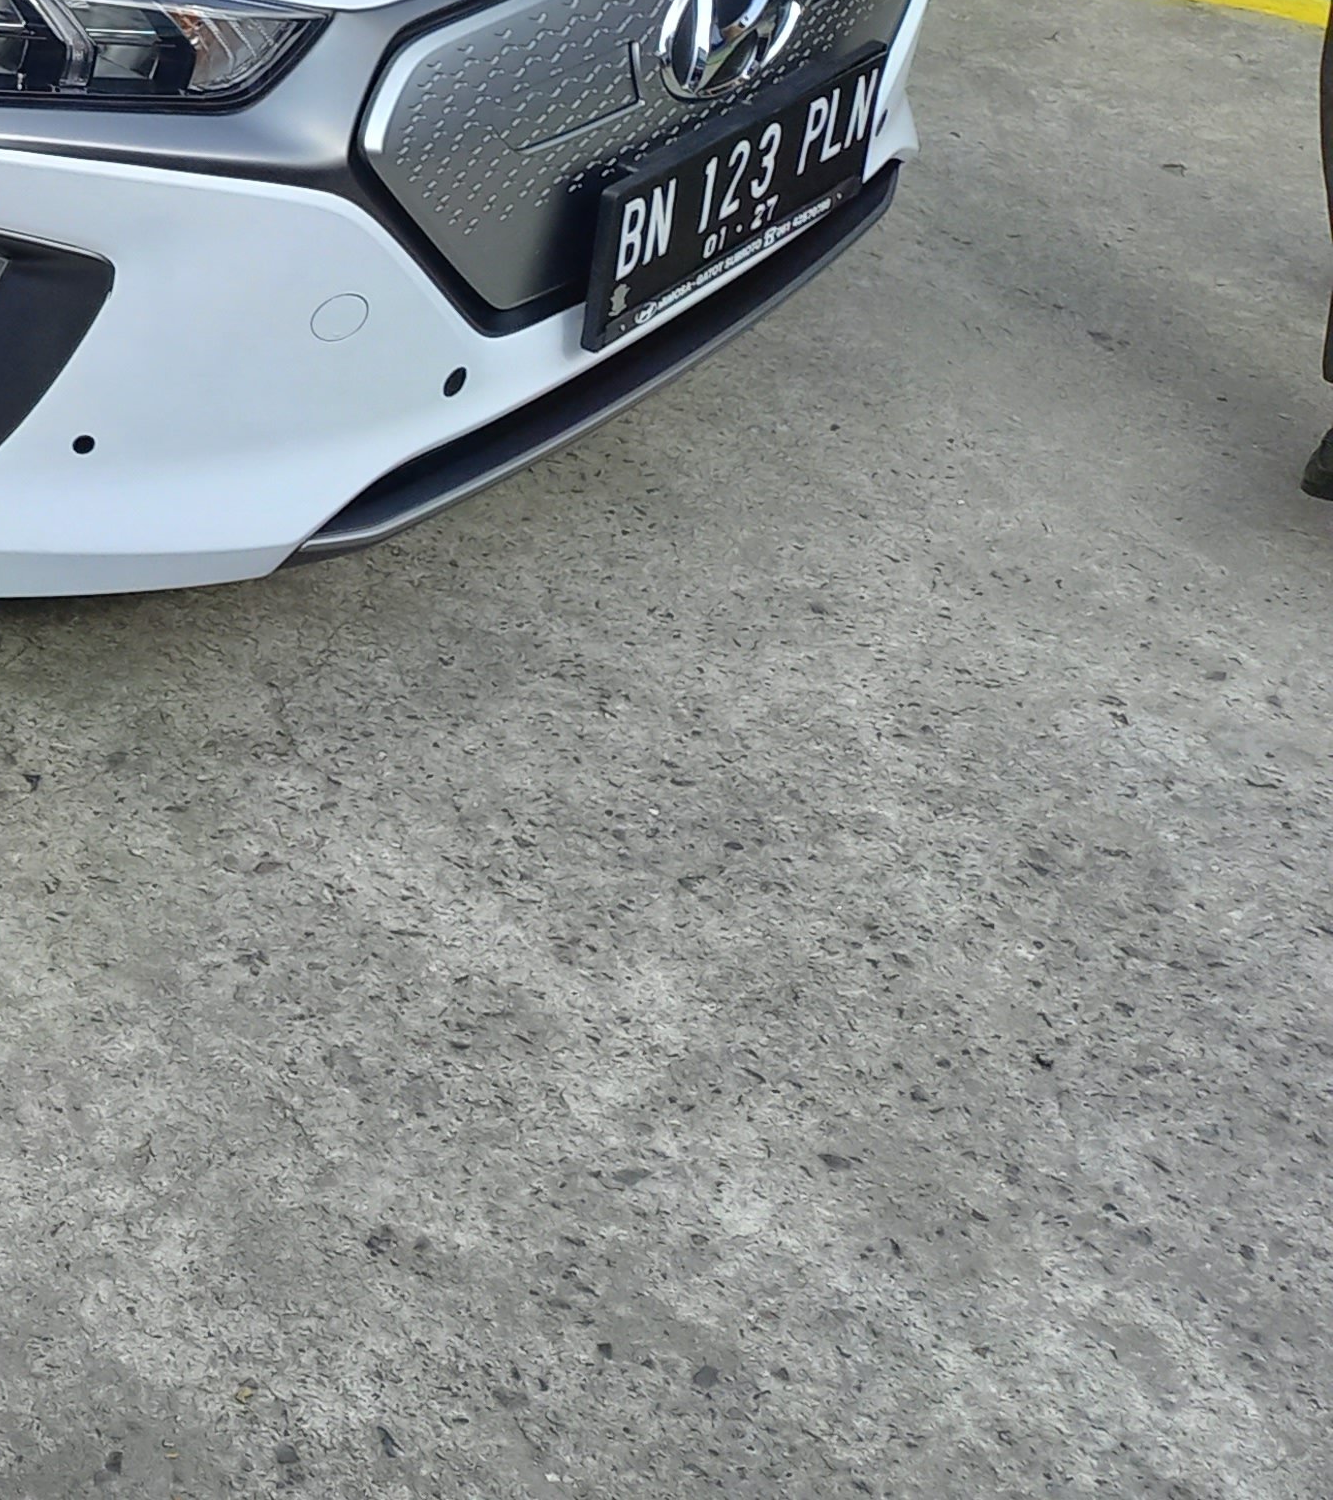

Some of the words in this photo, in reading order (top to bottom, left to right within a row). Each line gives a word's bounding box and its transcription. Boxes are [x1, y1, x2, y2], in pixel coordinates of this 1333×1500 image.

[615, 177, 677, 282] BN
[697, 122, 783, 235] 123
[796, 67, 880, 176] PLN
